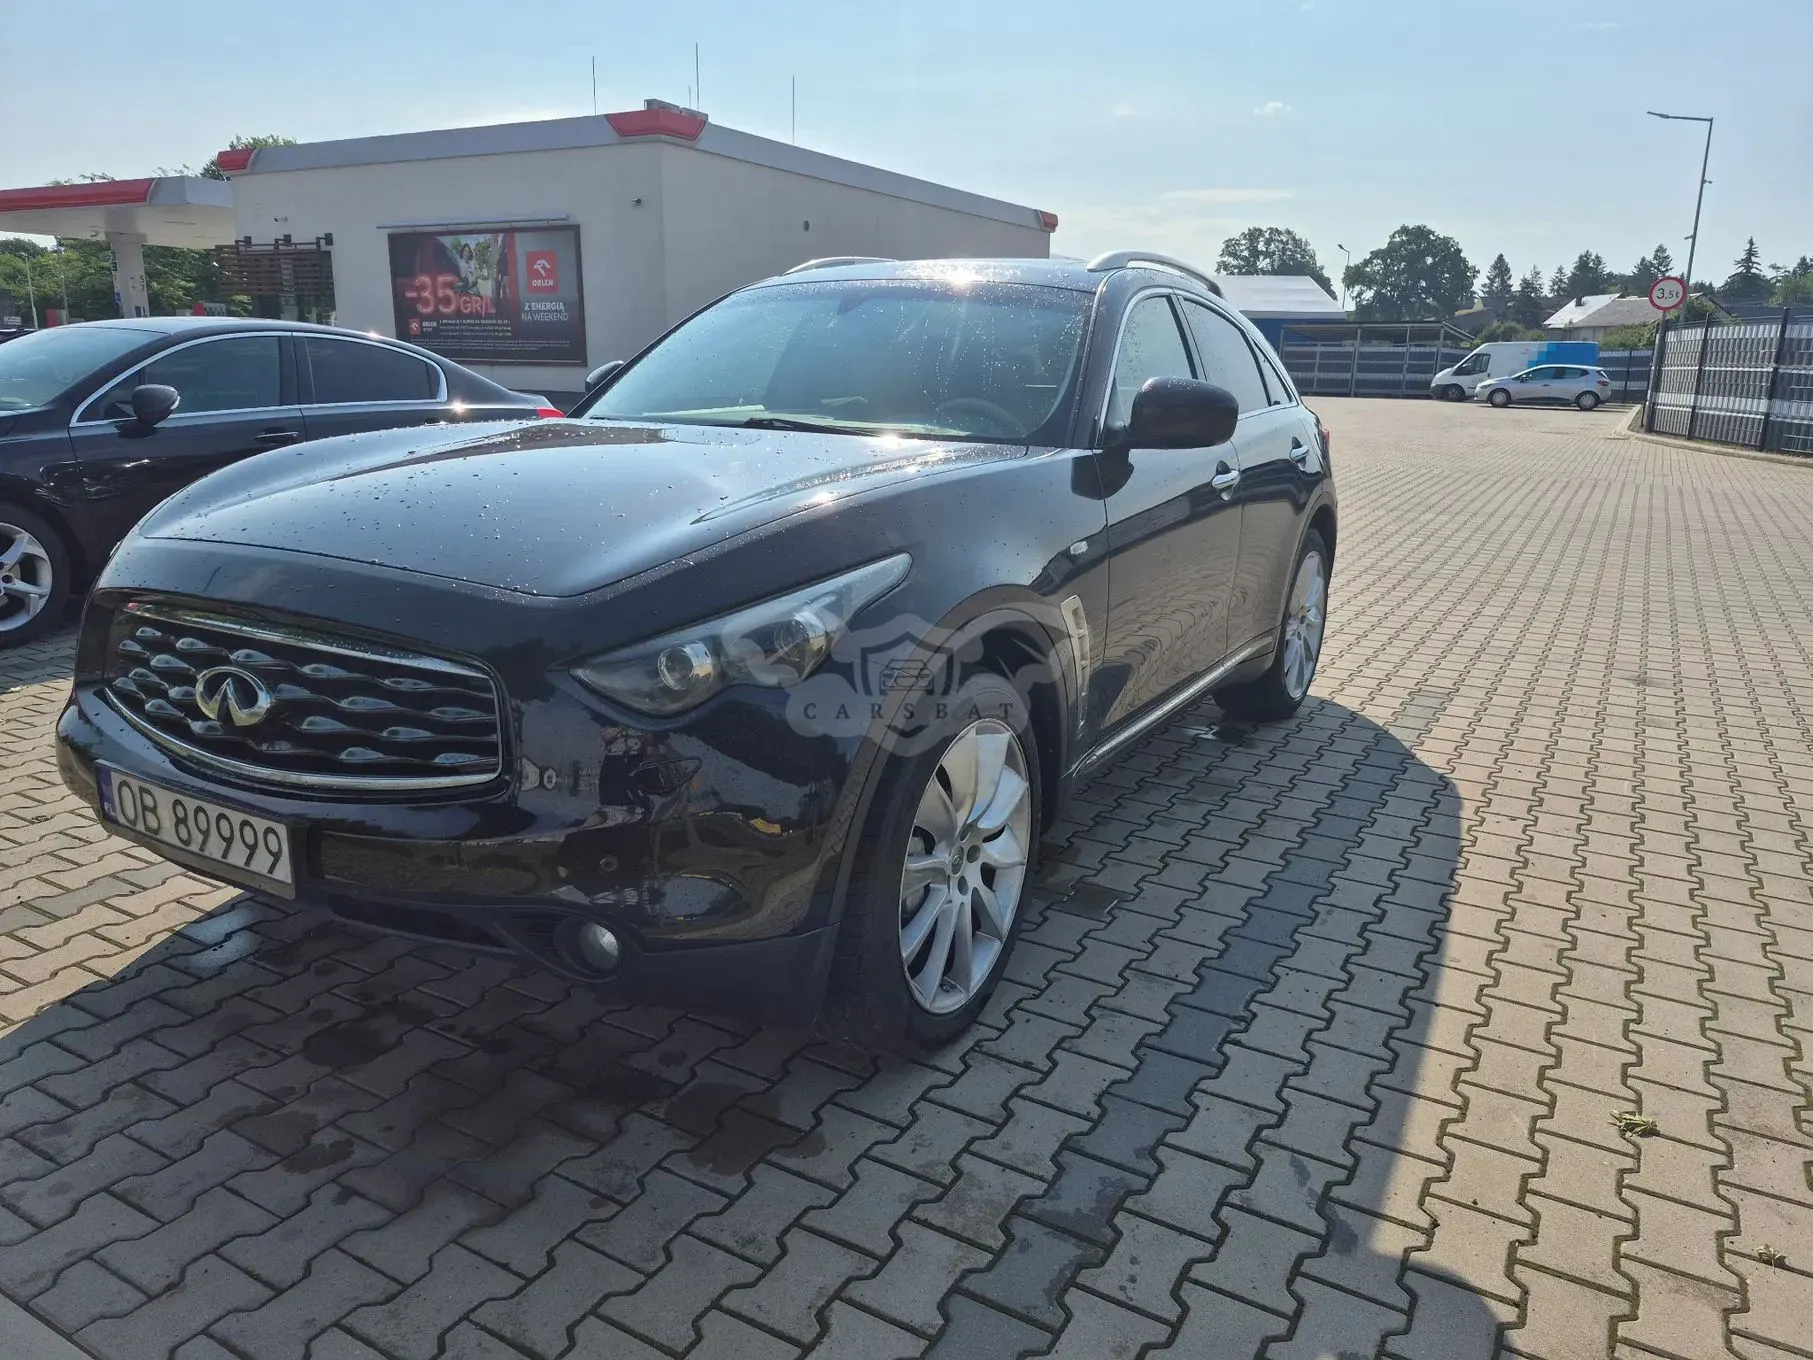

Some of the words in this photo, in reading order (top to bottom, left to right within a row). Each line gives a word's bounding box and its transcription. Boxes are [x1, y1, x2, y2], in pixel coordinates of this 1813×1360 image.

[532, 279, 554, 287] ORLEN
[405, 276, 456, 313] -35
[460, 297, 497, 316] GR/L
[524, 302, 530, 310] Z
[531, 302, 565, 312] ENERGIĄ
[521, 312, 533, 320] NA
[533, 311, 568, 321] WEEKEND
[103, 801, 116, 816] PL
[117, 779, 161, 835] OB
[172, 799, 282, 875] 89999
